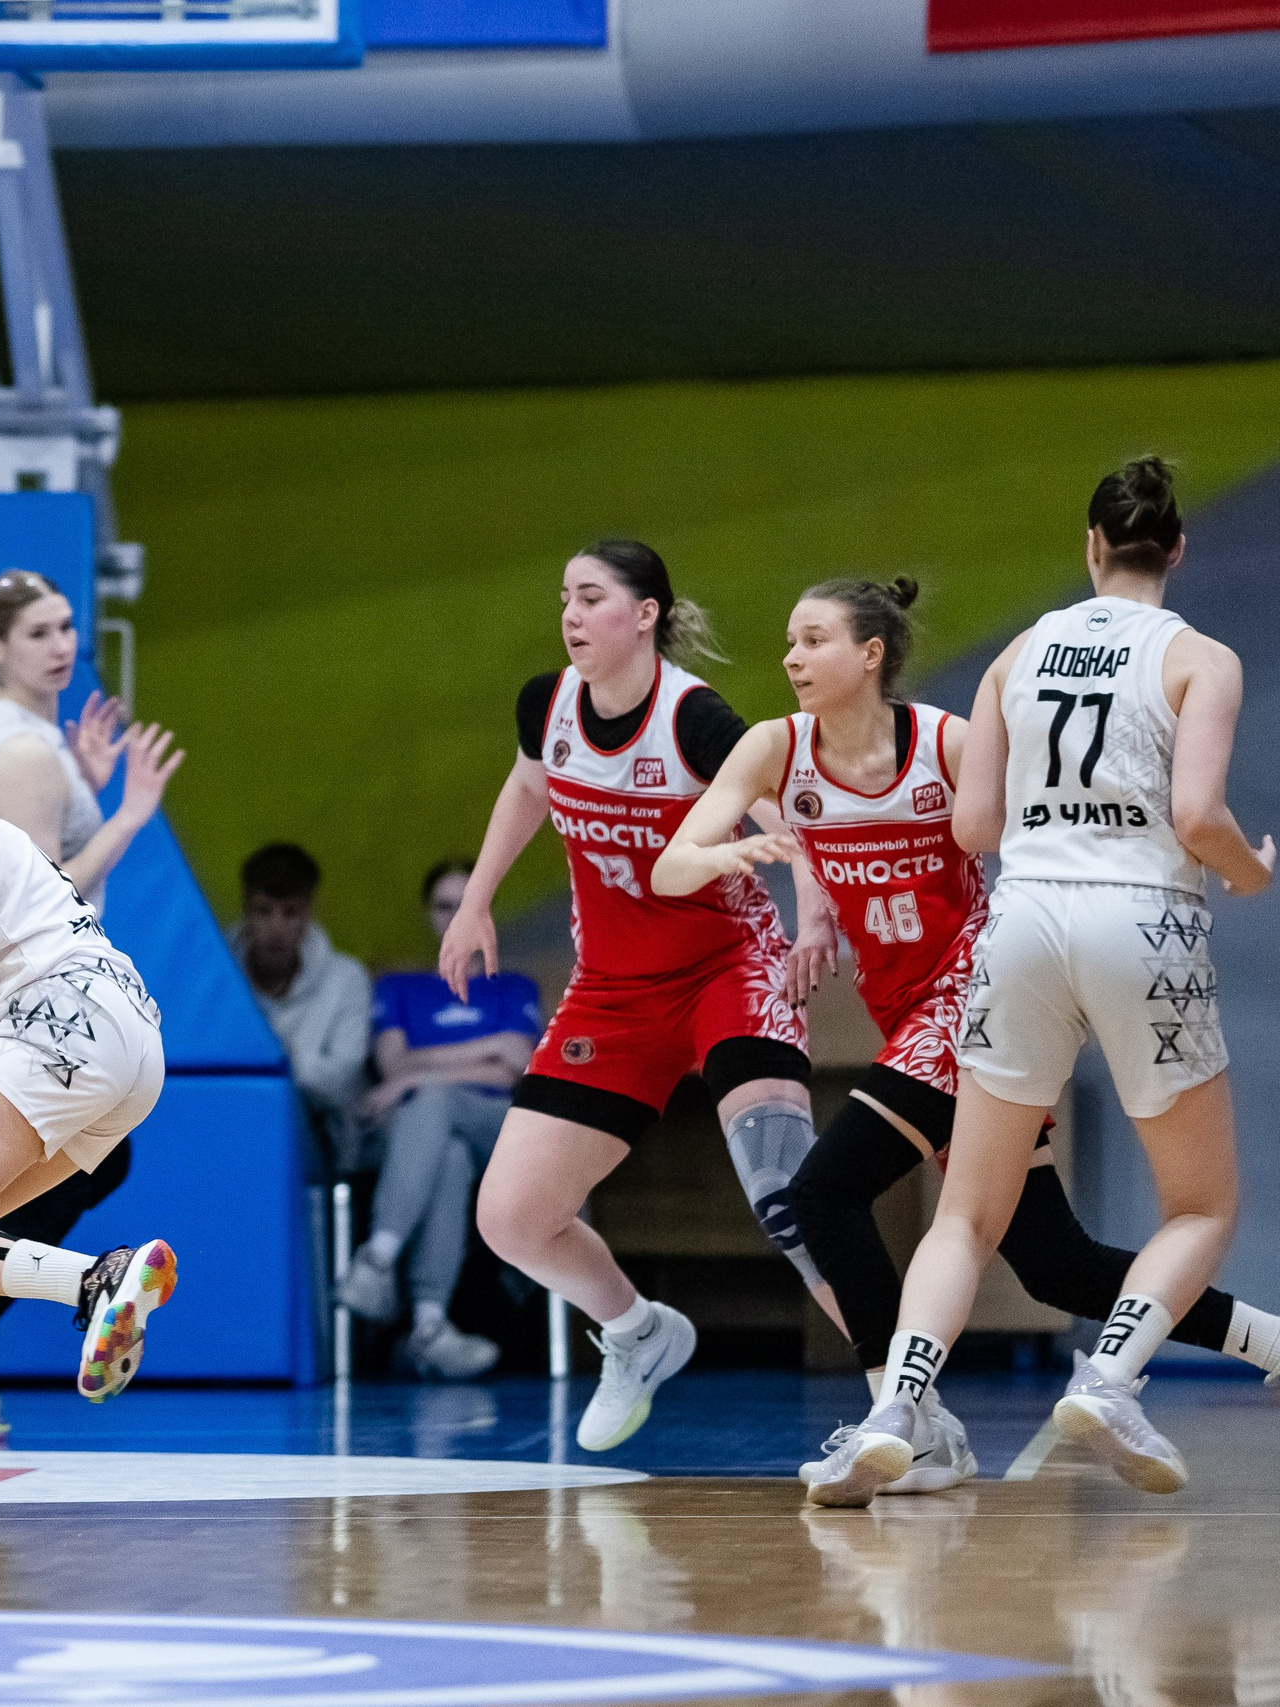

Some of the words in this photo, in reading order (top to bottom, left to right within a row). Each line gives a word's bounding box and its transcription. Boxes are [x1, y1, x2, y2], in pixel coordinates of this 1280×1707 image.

[1036, 643, 1131, 679] ДОВНАР
[1036, 689, 1114, 789] 77
[636, 760, 662, 773] FON
[635, 772, 663, 785] BET
[915, 784, 941, 800] FON
[915, 795, 942, 812] BET
[630, 806, 661, 819] КЛУБ
[913, 833, 943, 848] КЛУБ
[820, 853, 944, 885] ЮНОСТЬ
[864, 890, 924, 945] 46
